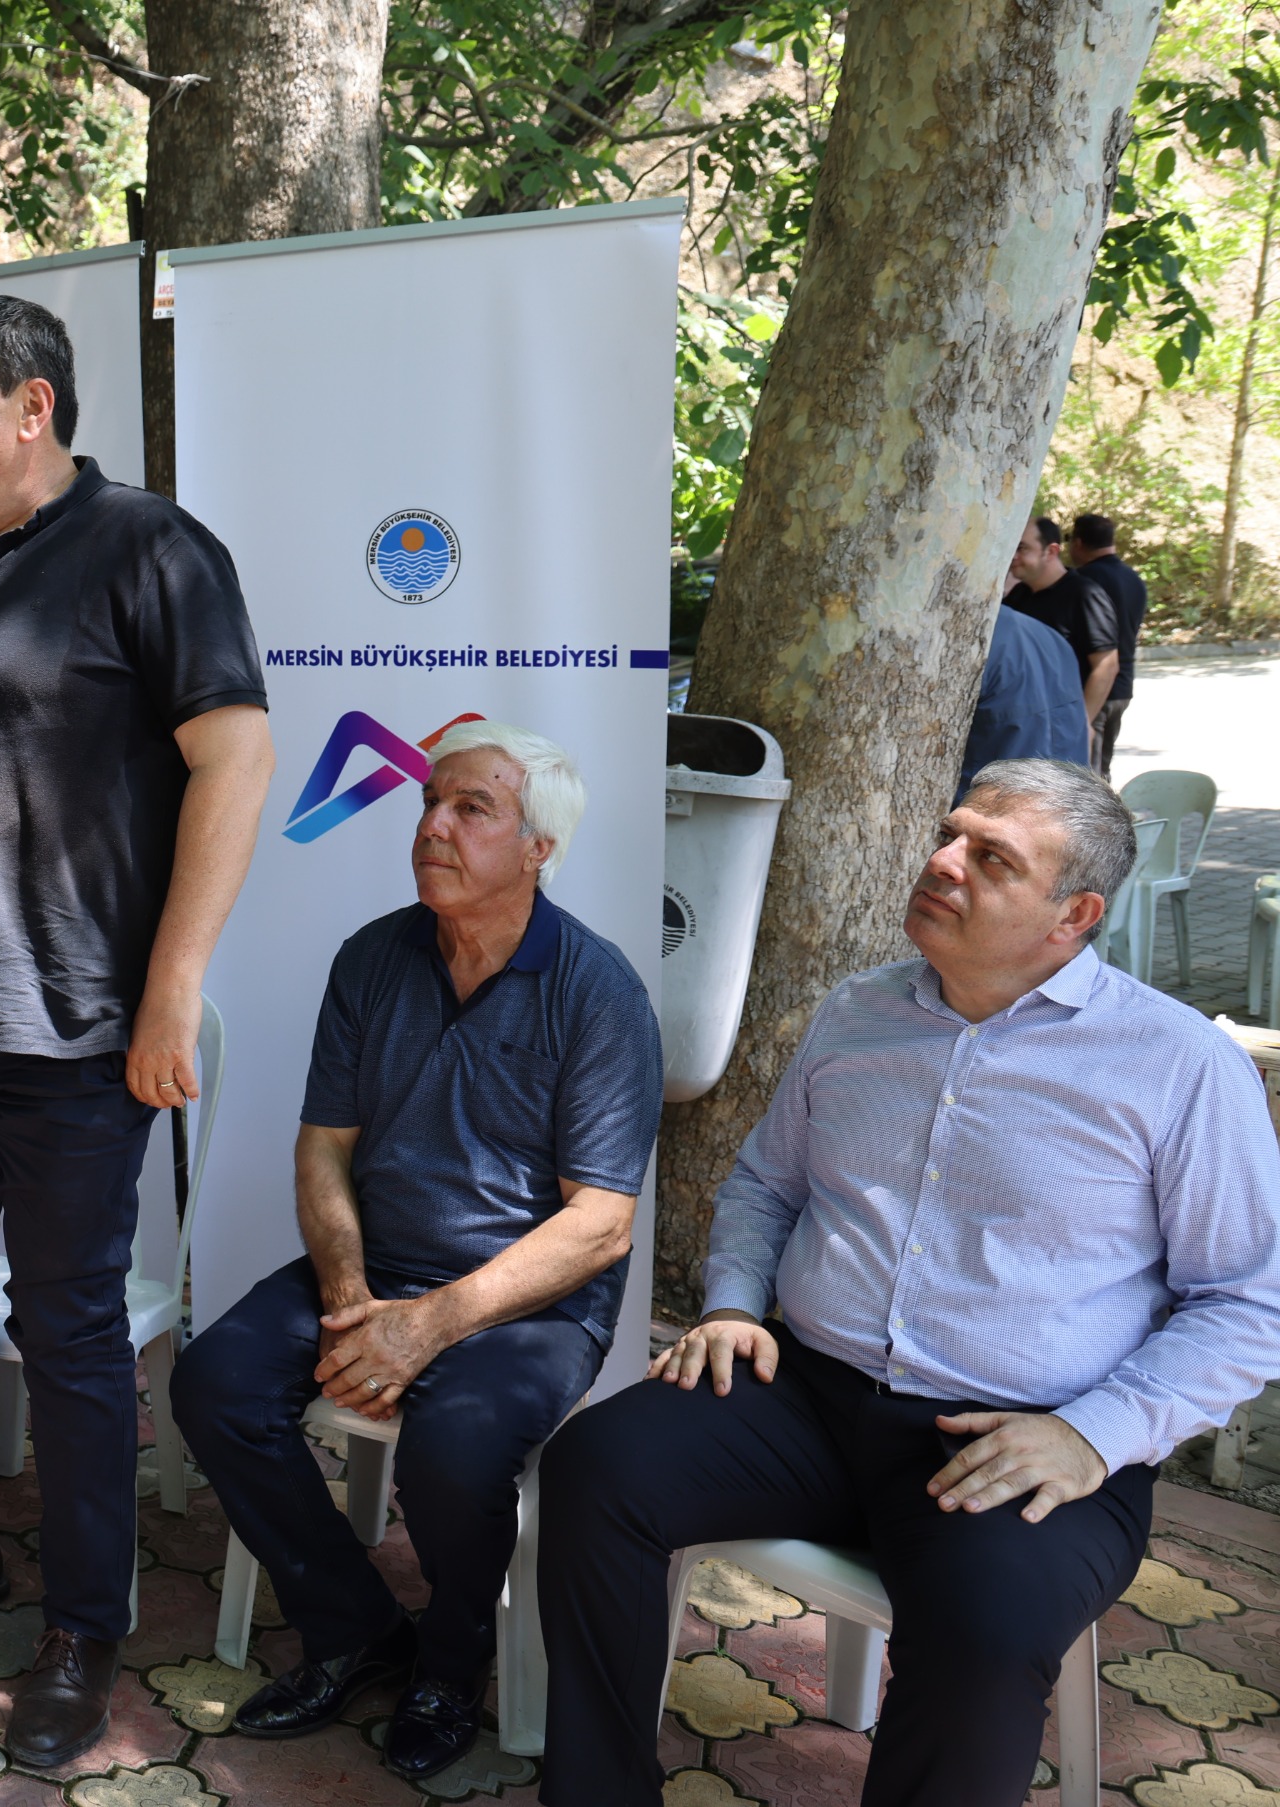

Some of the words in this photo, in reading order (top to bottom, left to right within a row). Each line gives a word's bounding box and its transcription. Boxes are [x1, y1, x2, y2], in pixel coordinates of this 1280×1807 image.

[370, 533, 382, 565] MERSİN
[380, 512, 432, 533] BÜYÜKŞEHİR
[432, 518, 458, 563] BELEDİYESİ
[402, 594, 423, 602] 1873
[266, 644, 343, 666] MERSİN
[351, 644, 488, 672] BÜYÜKŞEHİR
[496, 644, 618, 668] BELEDİYESİ
[674, 891, 697, 938] BELEDİYESİ
